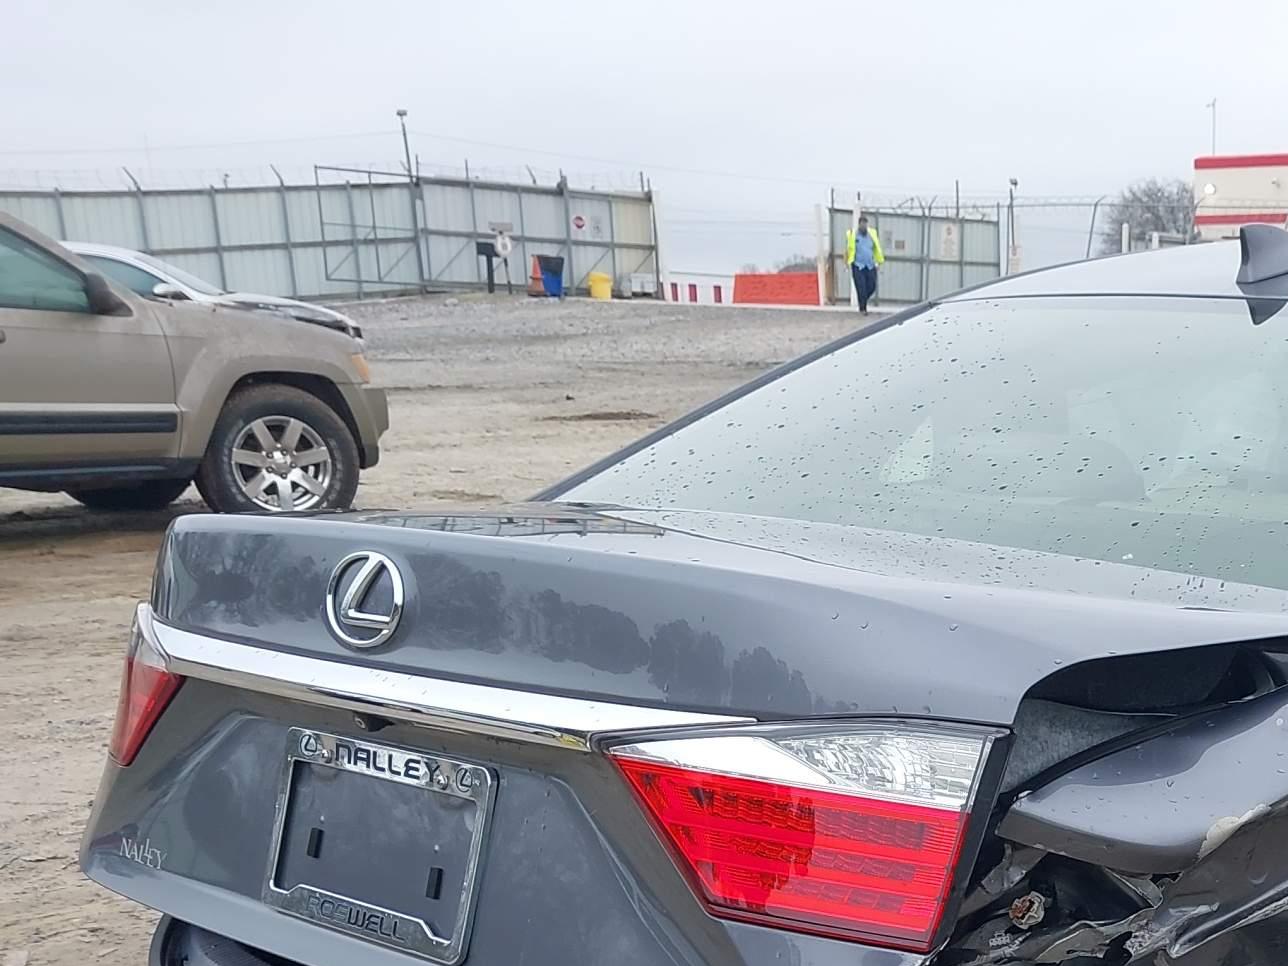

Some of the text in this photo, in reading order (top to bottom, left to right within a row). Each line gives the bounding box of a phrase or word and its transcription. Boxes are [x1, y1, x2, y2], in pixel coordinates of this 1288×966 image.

[336, 742, 440, 782] NALLEY
[119, 837, 167, 869] NALLEY
[306, 896, 406, 942] ROSWELL
